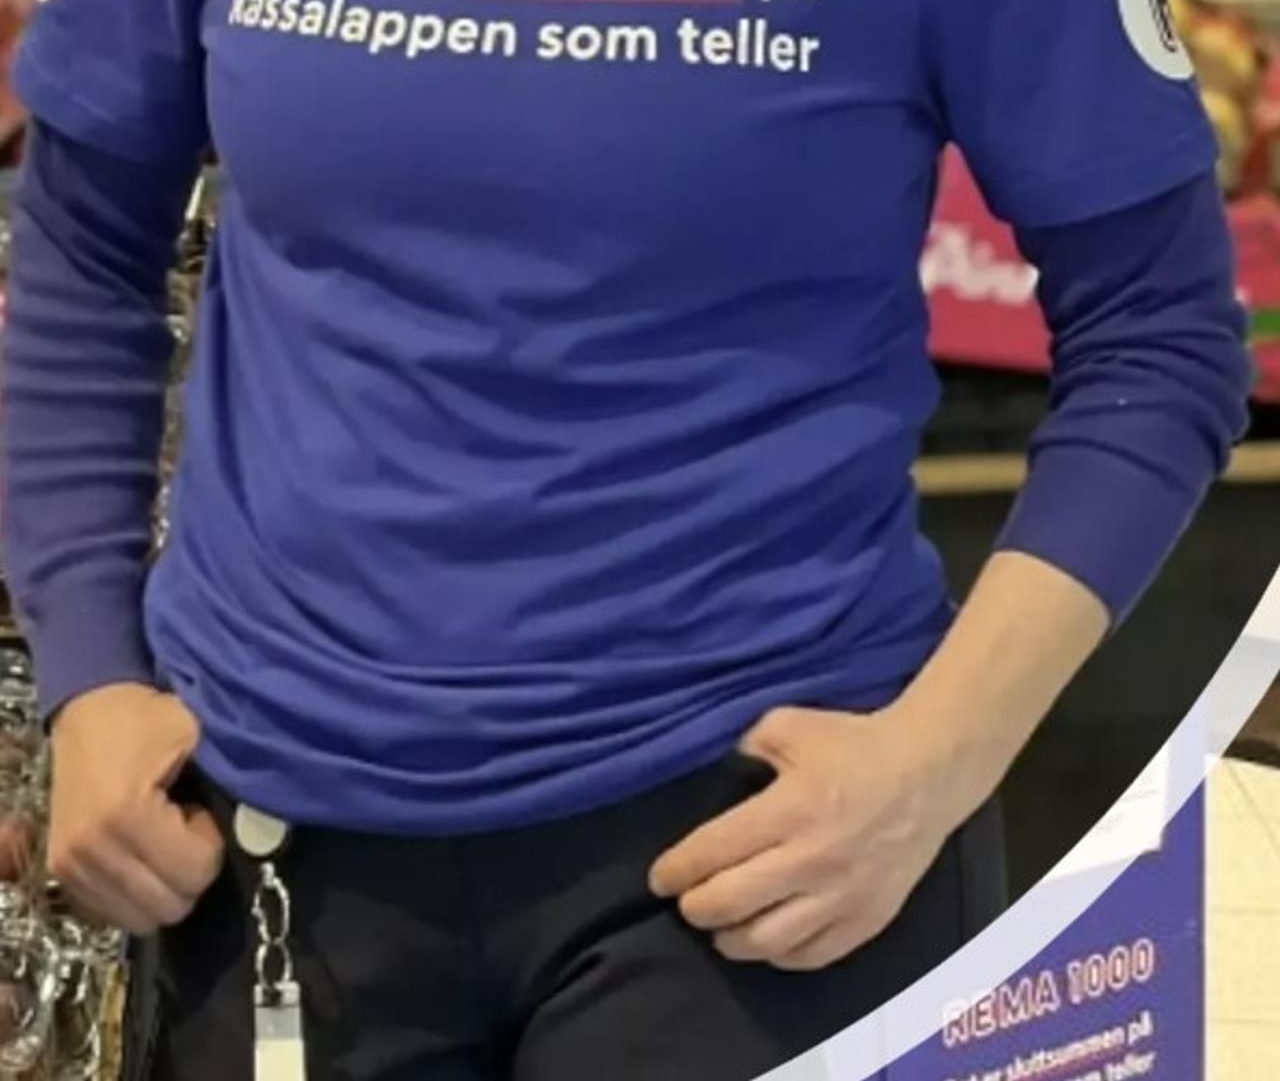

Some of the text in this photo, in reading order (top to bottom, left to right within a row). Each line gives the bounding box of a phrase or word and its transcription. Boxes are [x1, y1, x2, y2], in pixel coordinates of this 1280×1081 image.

[537, 21, 658, 61] som
[677, 19, 820, 72] teller
[942, 937, 1156, 1048] REMA 1000
